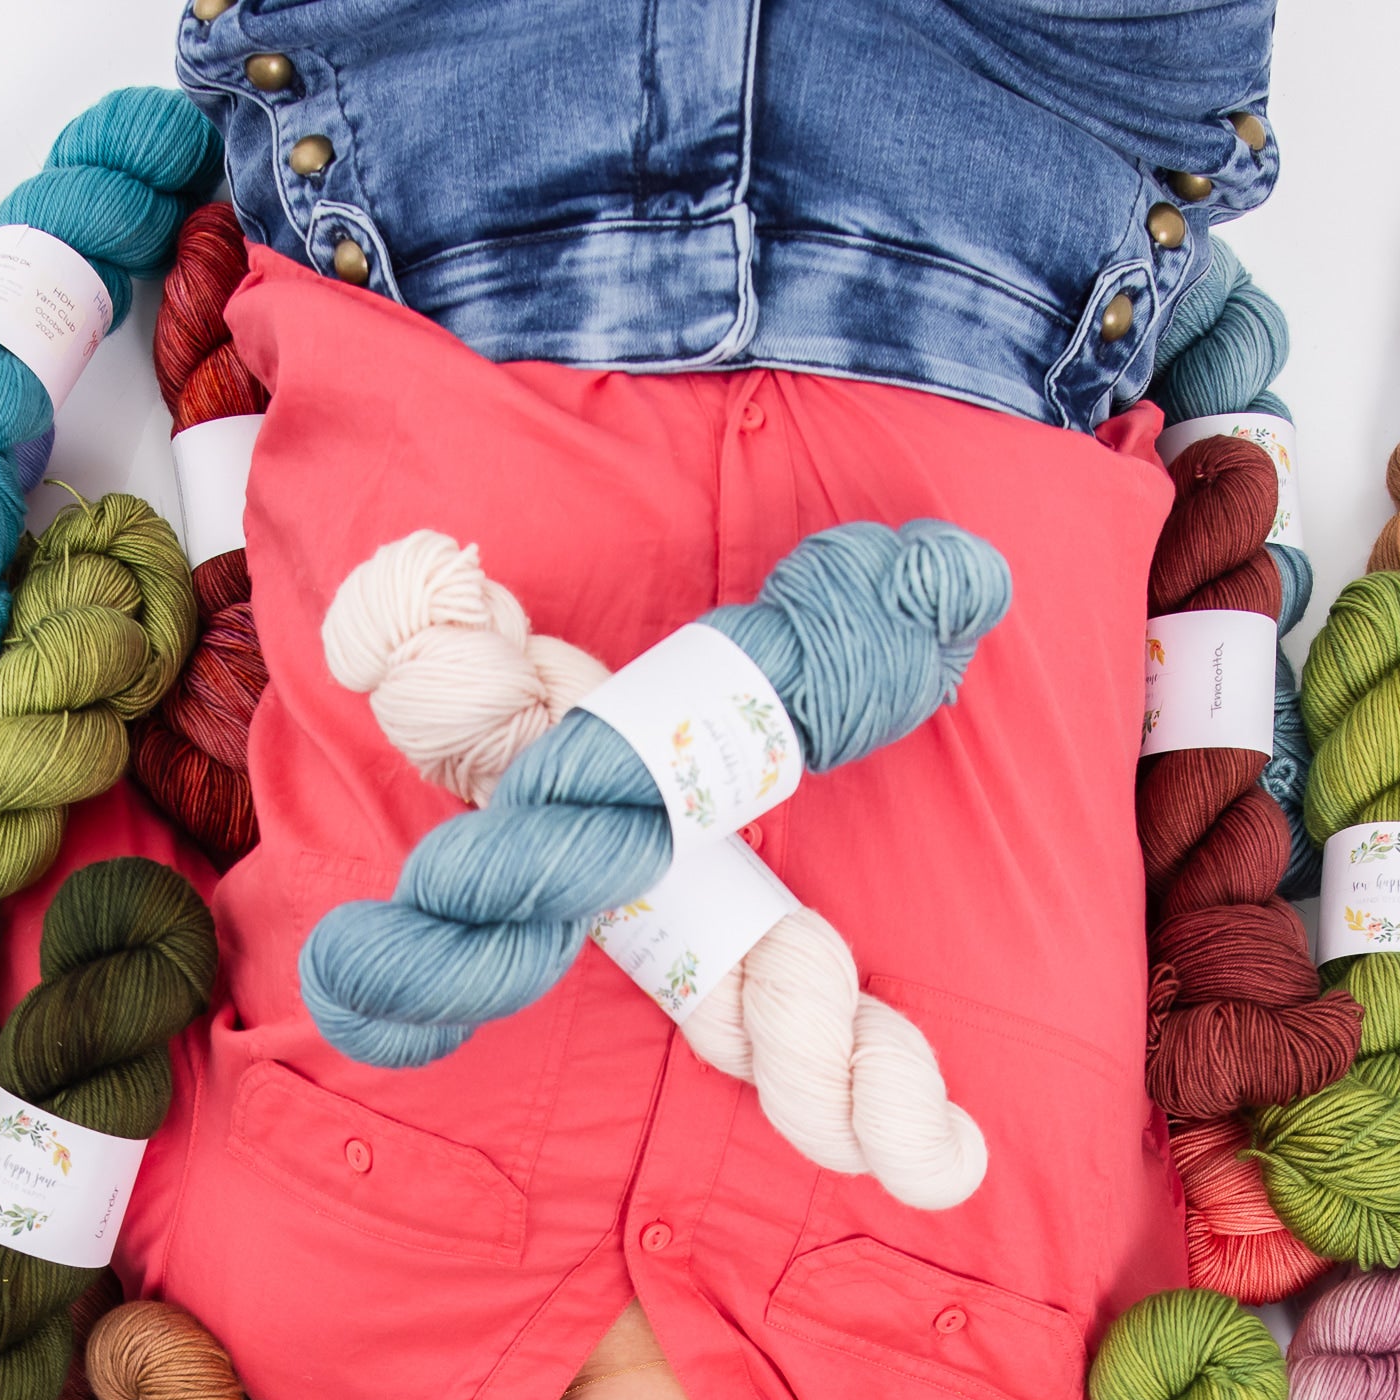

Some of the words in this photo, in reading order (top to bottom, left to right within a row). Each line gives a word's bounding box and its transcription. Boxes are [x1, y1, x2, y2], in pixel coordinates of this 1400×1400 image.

[36, 289, 57, 311] Yarn
[57, 309, 76, 333] Club
[52, 287, 76, 311] HDH
[35, 306, 65, 337] October
[35, 320, 55, 341] 2022
[1206, 640, 1228, 719] Terracotta
[1352, 882, 1367, 892] sew
[95, 1188, 119, 1239] Wander
